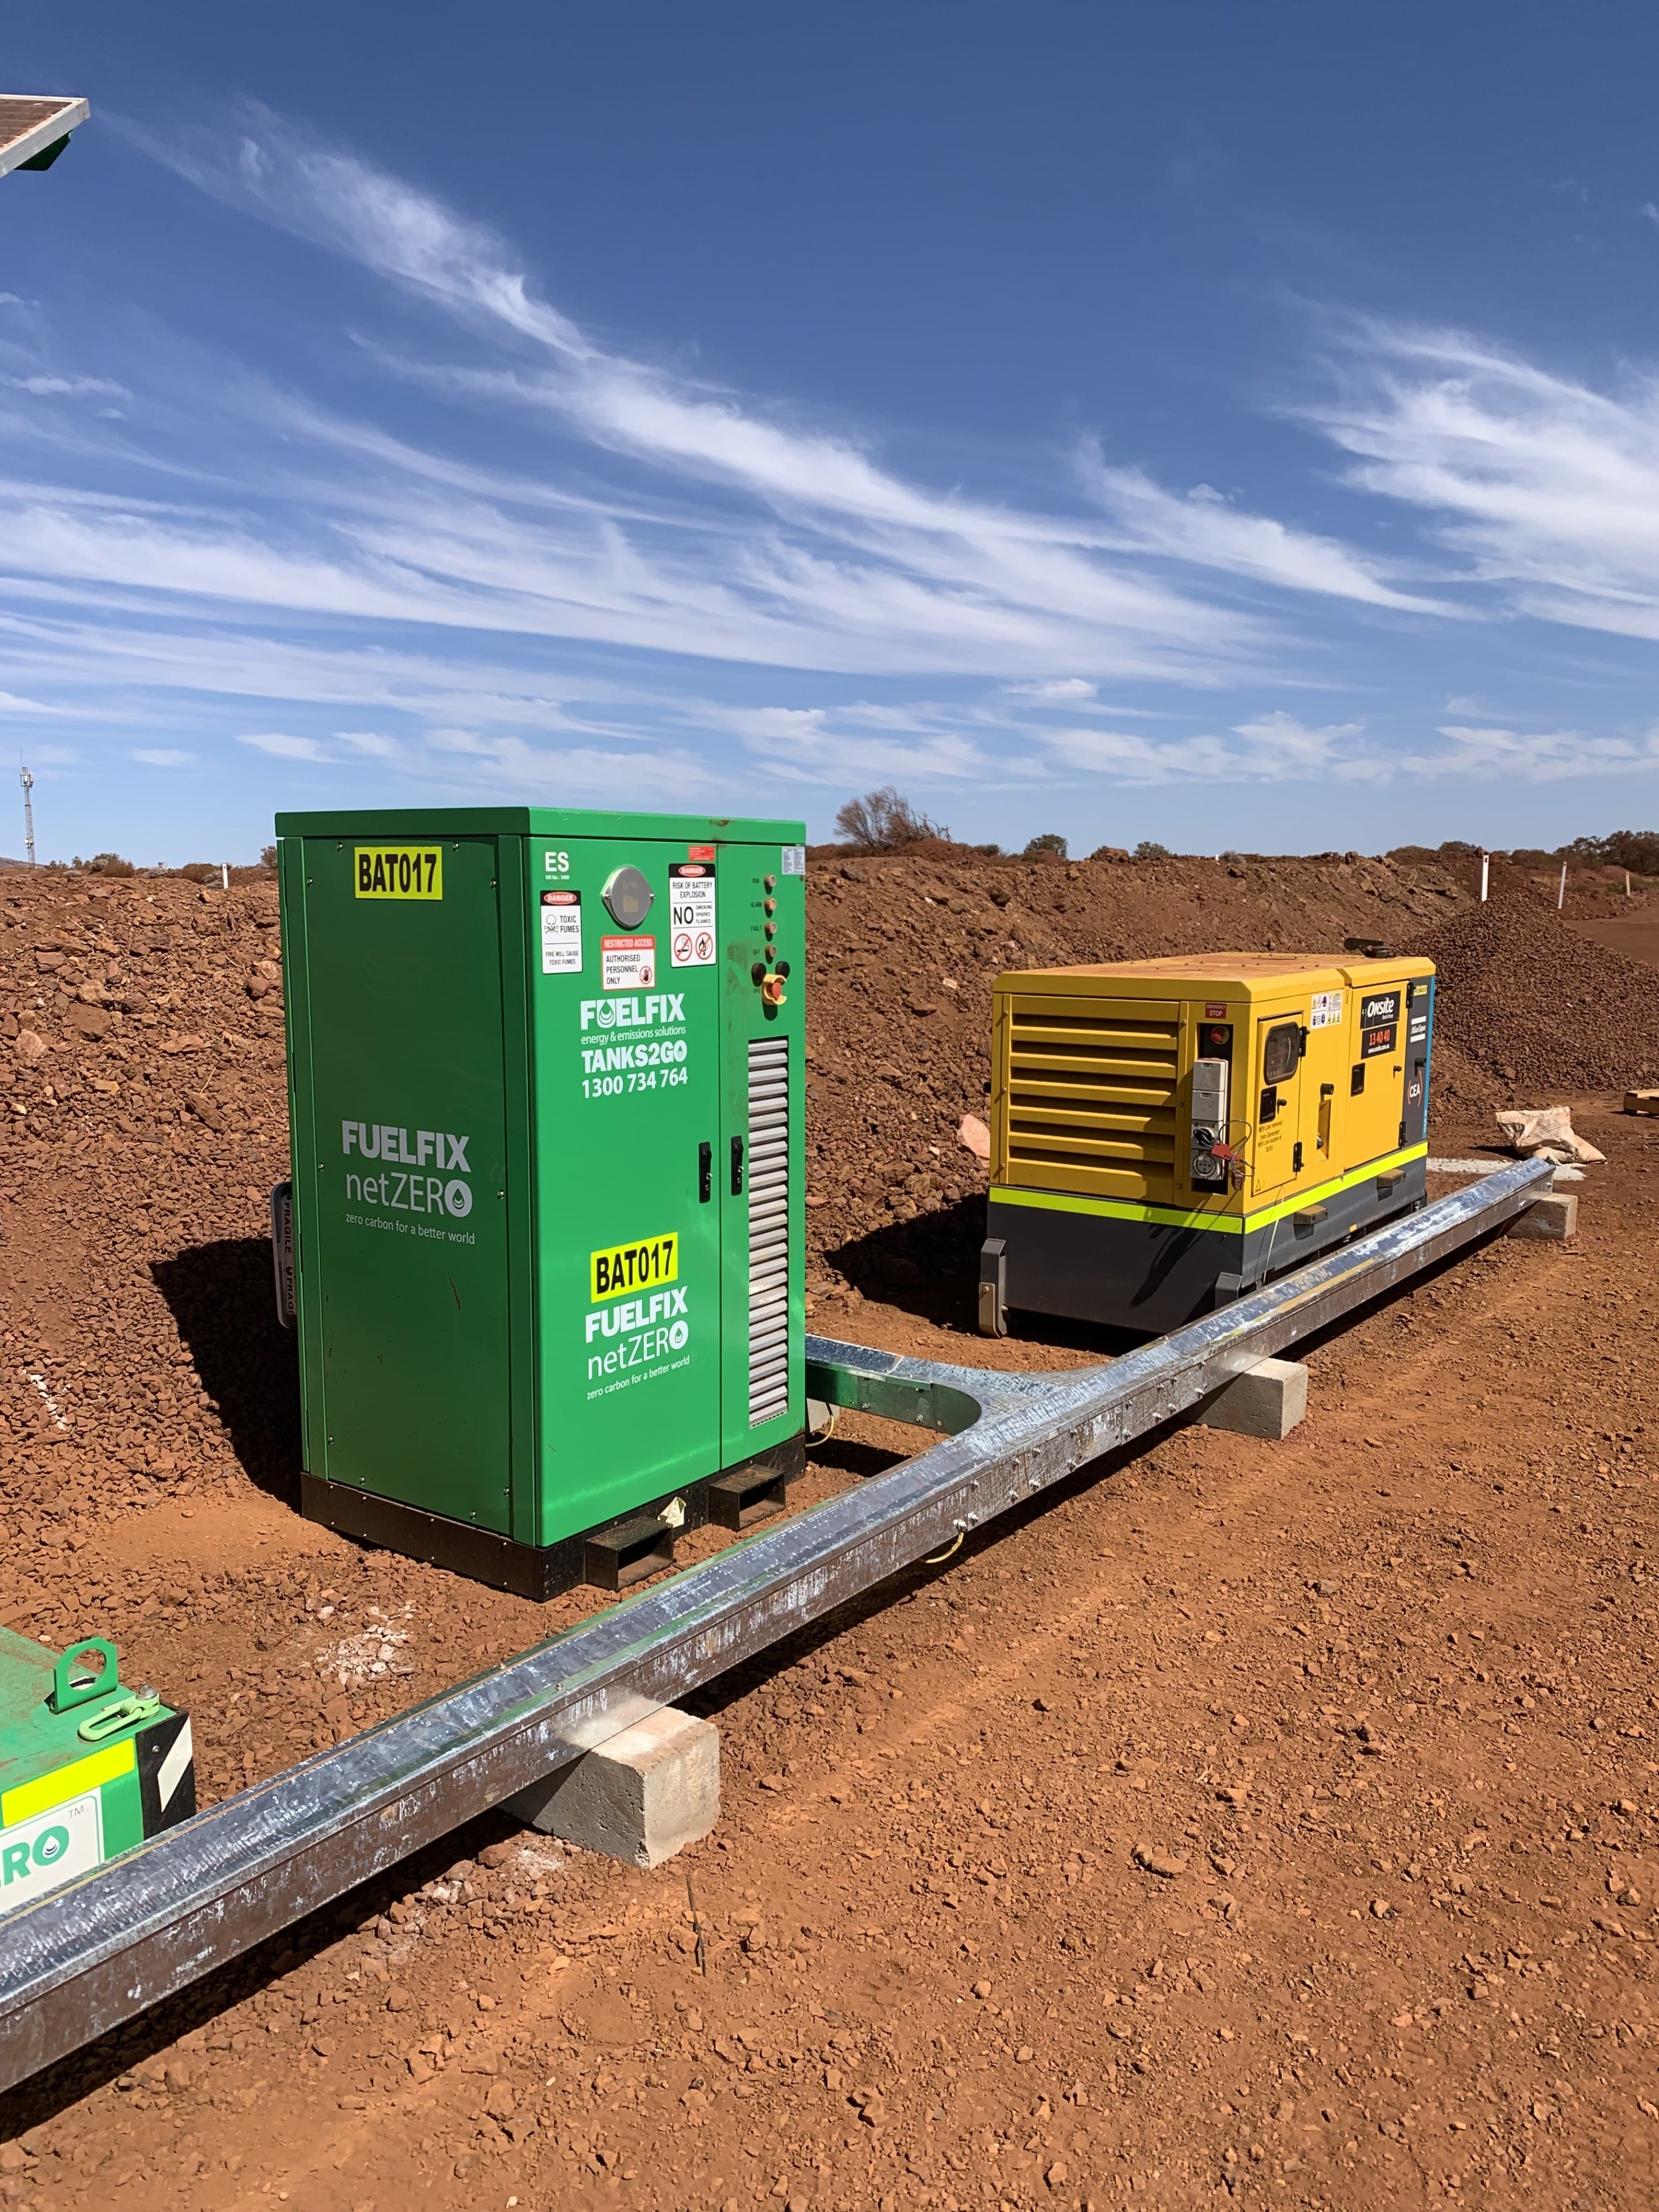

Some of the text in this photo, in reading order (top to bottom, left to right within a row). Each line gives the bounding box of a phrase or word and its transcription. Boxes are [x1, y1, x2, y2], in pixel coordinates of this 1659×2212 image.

[359, 853, 437, 892] BAT017
[545, 851, 569, 872] ES
[673, 906, 694, 925] NO
[604, 938, 653, 948] RESTRICTED ACCESS
[606, 954, 641, 963] AUTHORISED
[606, 965, 638, 974] PERSONNEL
[607, 976, 620, 984] ONLY
[581, 993, 685, 1030] FUELFIX
[581, 1025, 686, 1046] energy & emissions solutions
[1369, 1028, 1390, 1046] 13 40 40
[581, 1040, 687, 1073] TANKS2GO
[582, 1067, 688, 1098] 1300 734 764
[1410, 1083, 1421, 1098] CEA
[342, 1120, 471, 1172] FUELFIX
[346, 1172, 472, 1217] netZERO
[284, 1202, 292, 1253] FRAGILE
[346, 1213, 475, 1244] zero carbon for a better world
[597, 1240, 673, 1294] BAT017
[585, 1286, 688, 1343] FUELFIX
[588, 1320, 688, 1380] netZERO
[586, 1388, 603, 1400] zero
[605, 1378, 630, 1393] carbon
[631, 1374, 642, 1385] for
[649, 1365, 669, 1378] better
[671, 1355, 690, 1370] world
[69, 1805, 84, 1819] TM
[0, 1825, 70, 1888] RO
